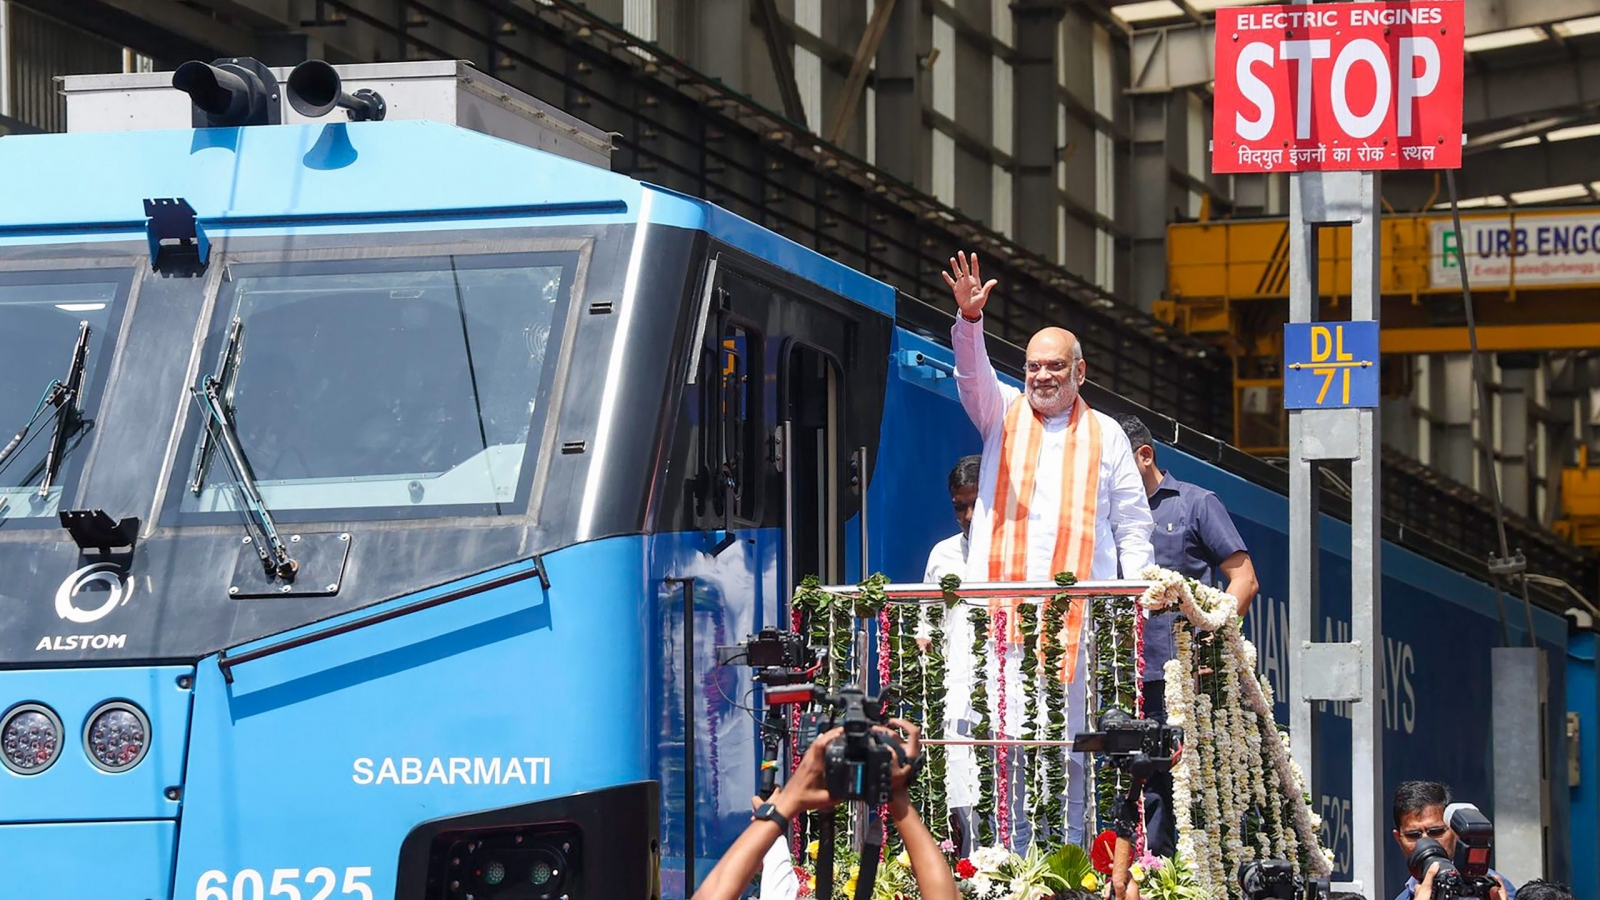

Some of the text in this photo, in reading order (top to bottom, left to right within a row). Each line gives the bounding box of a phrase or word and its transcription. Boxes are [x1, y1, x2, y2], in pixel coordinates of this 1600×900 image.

[1236, 7, 1443, 31] ELECTRIC ENGINES
[1235, 36, 1441, 141] STOP
[1289, 142, 1326, 166] इंजनों
[1332, 147, 1351, 162] का
[1357, 141, 1385, 161] रोक
[1402, 145, 1436, 161] स्थल
[1477, 226, 1528, 258] URB
[1310, 325, 1354, 362] DL
[1313, 367, 1351, 405] 71
[35, 634, 127, 651] ALSTOM
[352, 757, 551, 785] SABARMATI
[195, 866, 374, 900] 60525
